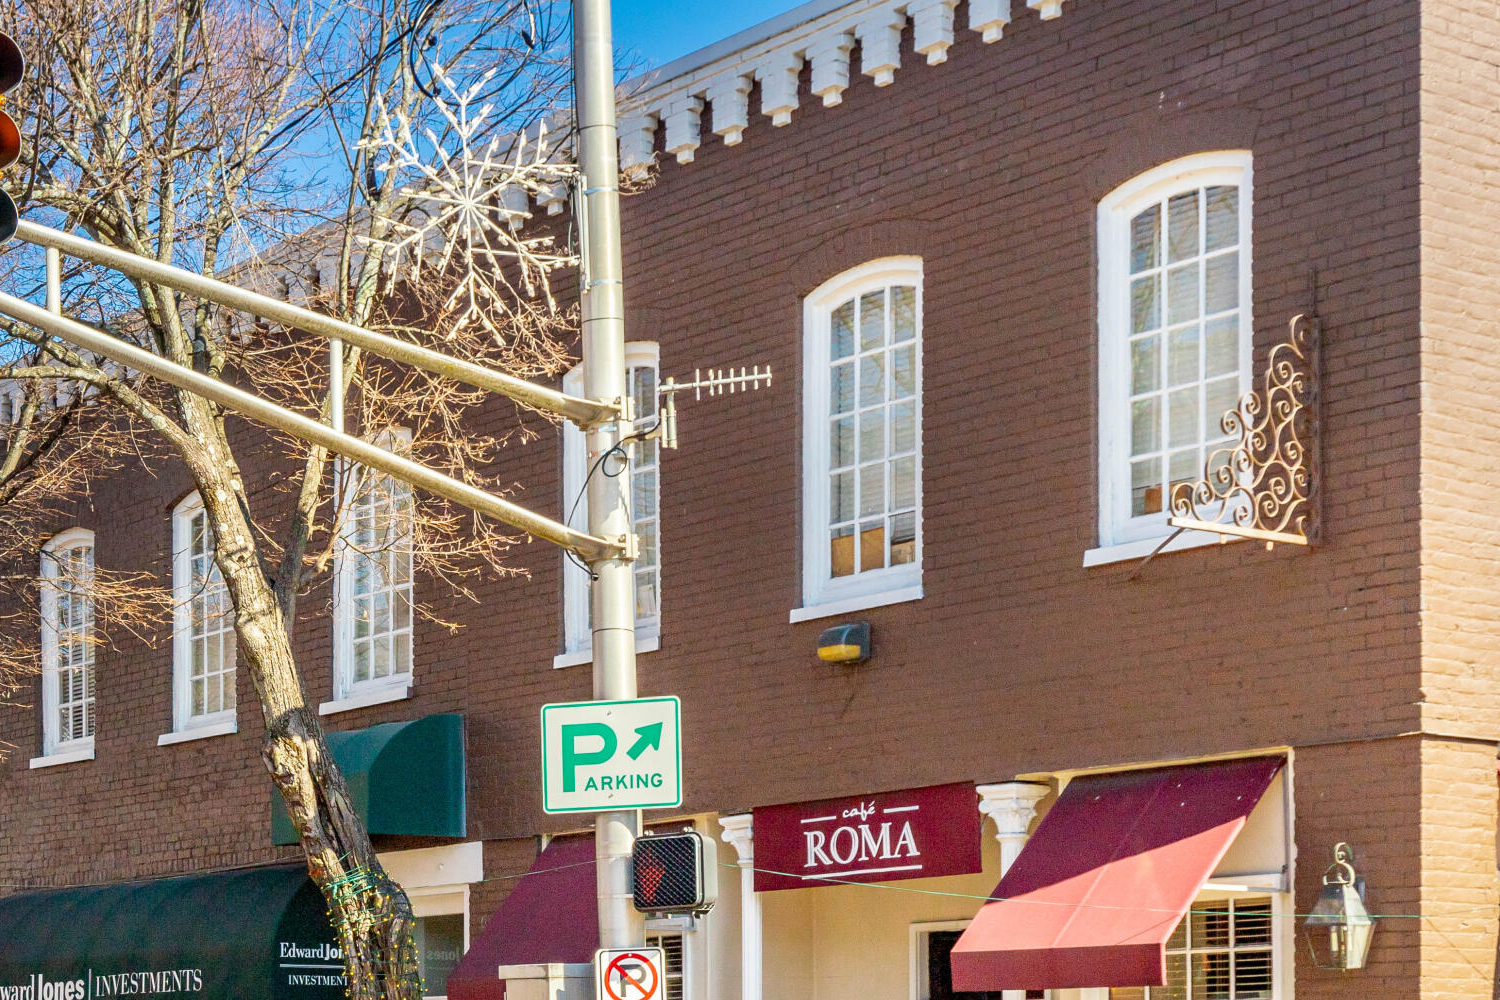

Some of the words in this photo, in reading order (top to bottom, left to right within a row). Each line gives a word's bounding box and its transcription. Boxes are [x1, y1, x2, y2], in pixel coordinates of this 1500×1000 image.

[842, 800, 876, 821] café
[803, 820, 920, 868] ROMA
[95, 968, 203, 997] INVESTMENTS
[288, 974, 348, 986] INVESTMENT
